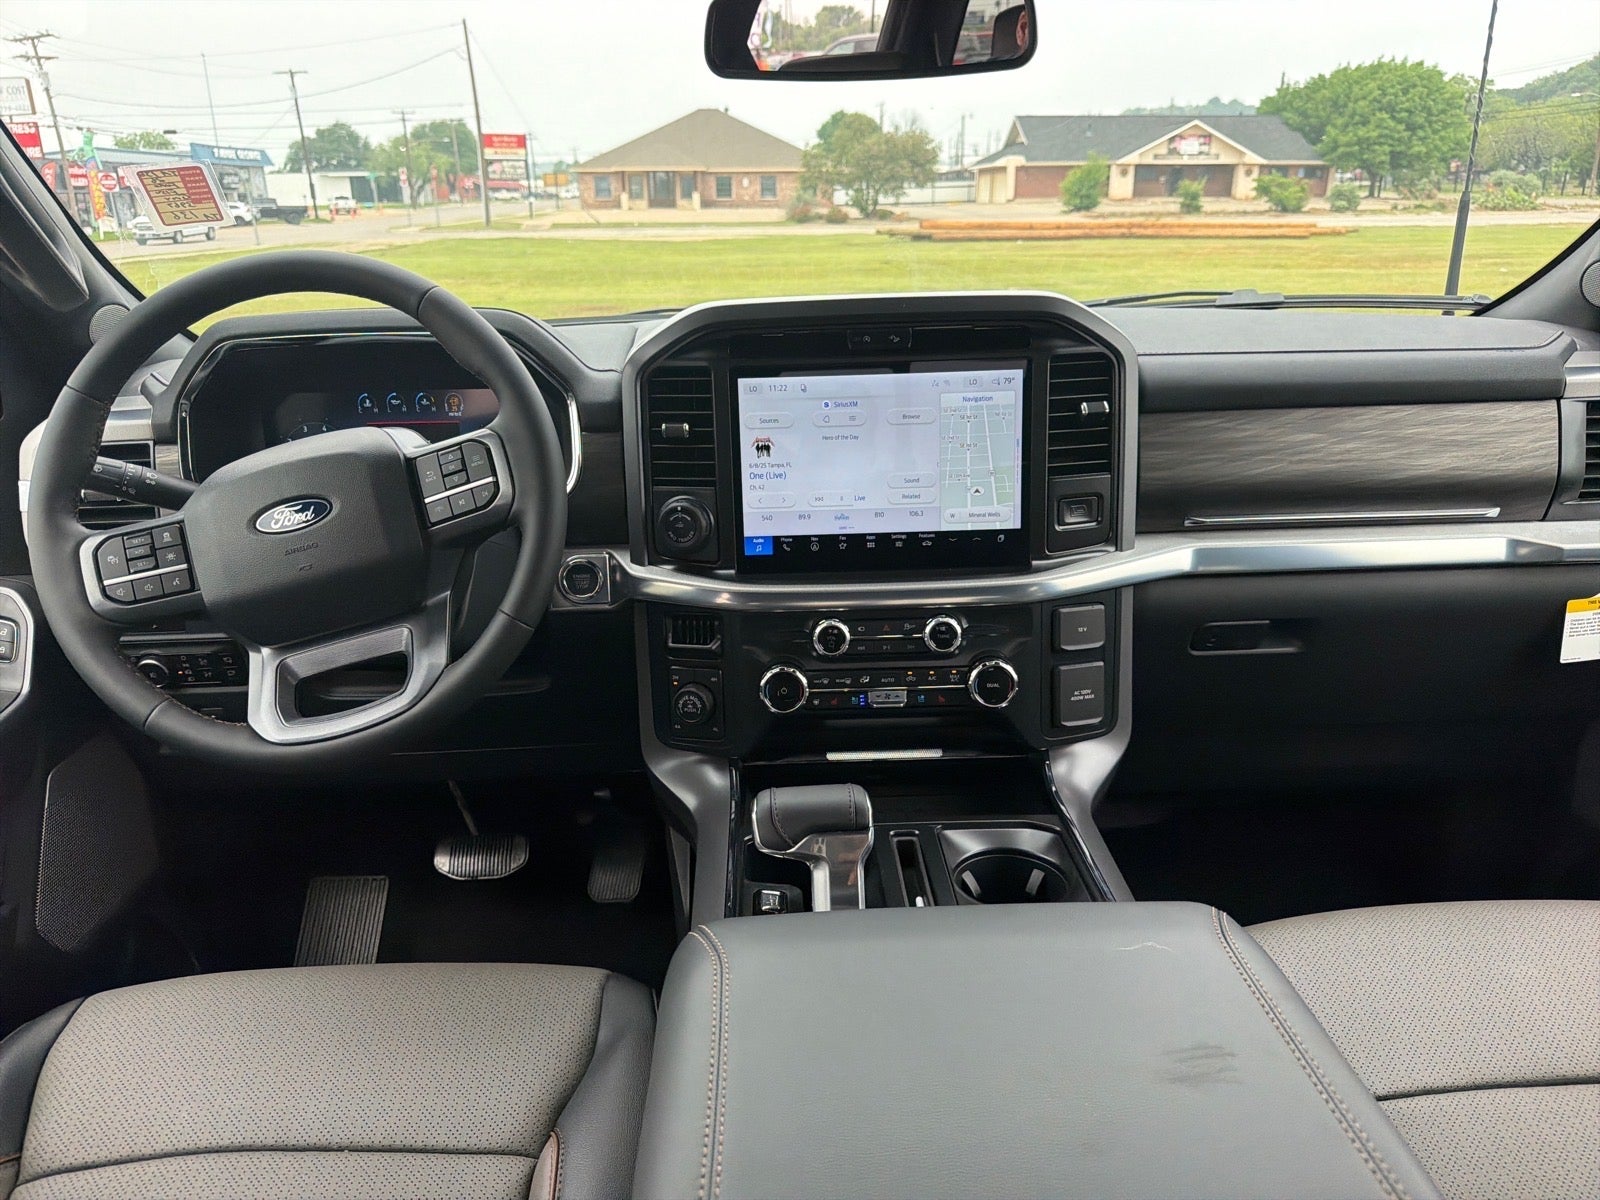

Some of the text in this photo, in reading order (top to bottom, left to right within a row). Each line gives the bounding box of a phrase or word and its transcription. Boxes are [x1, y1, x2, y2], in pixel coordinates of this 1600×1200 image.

[769, 384, 788, 392] 11:22
[962, 395, 994, 403] Navigation
[833, 400, 858, 408] SiriusXM
[749, 470, 787, 480] One (Live)
[270, 504, 315, 530] Ford
